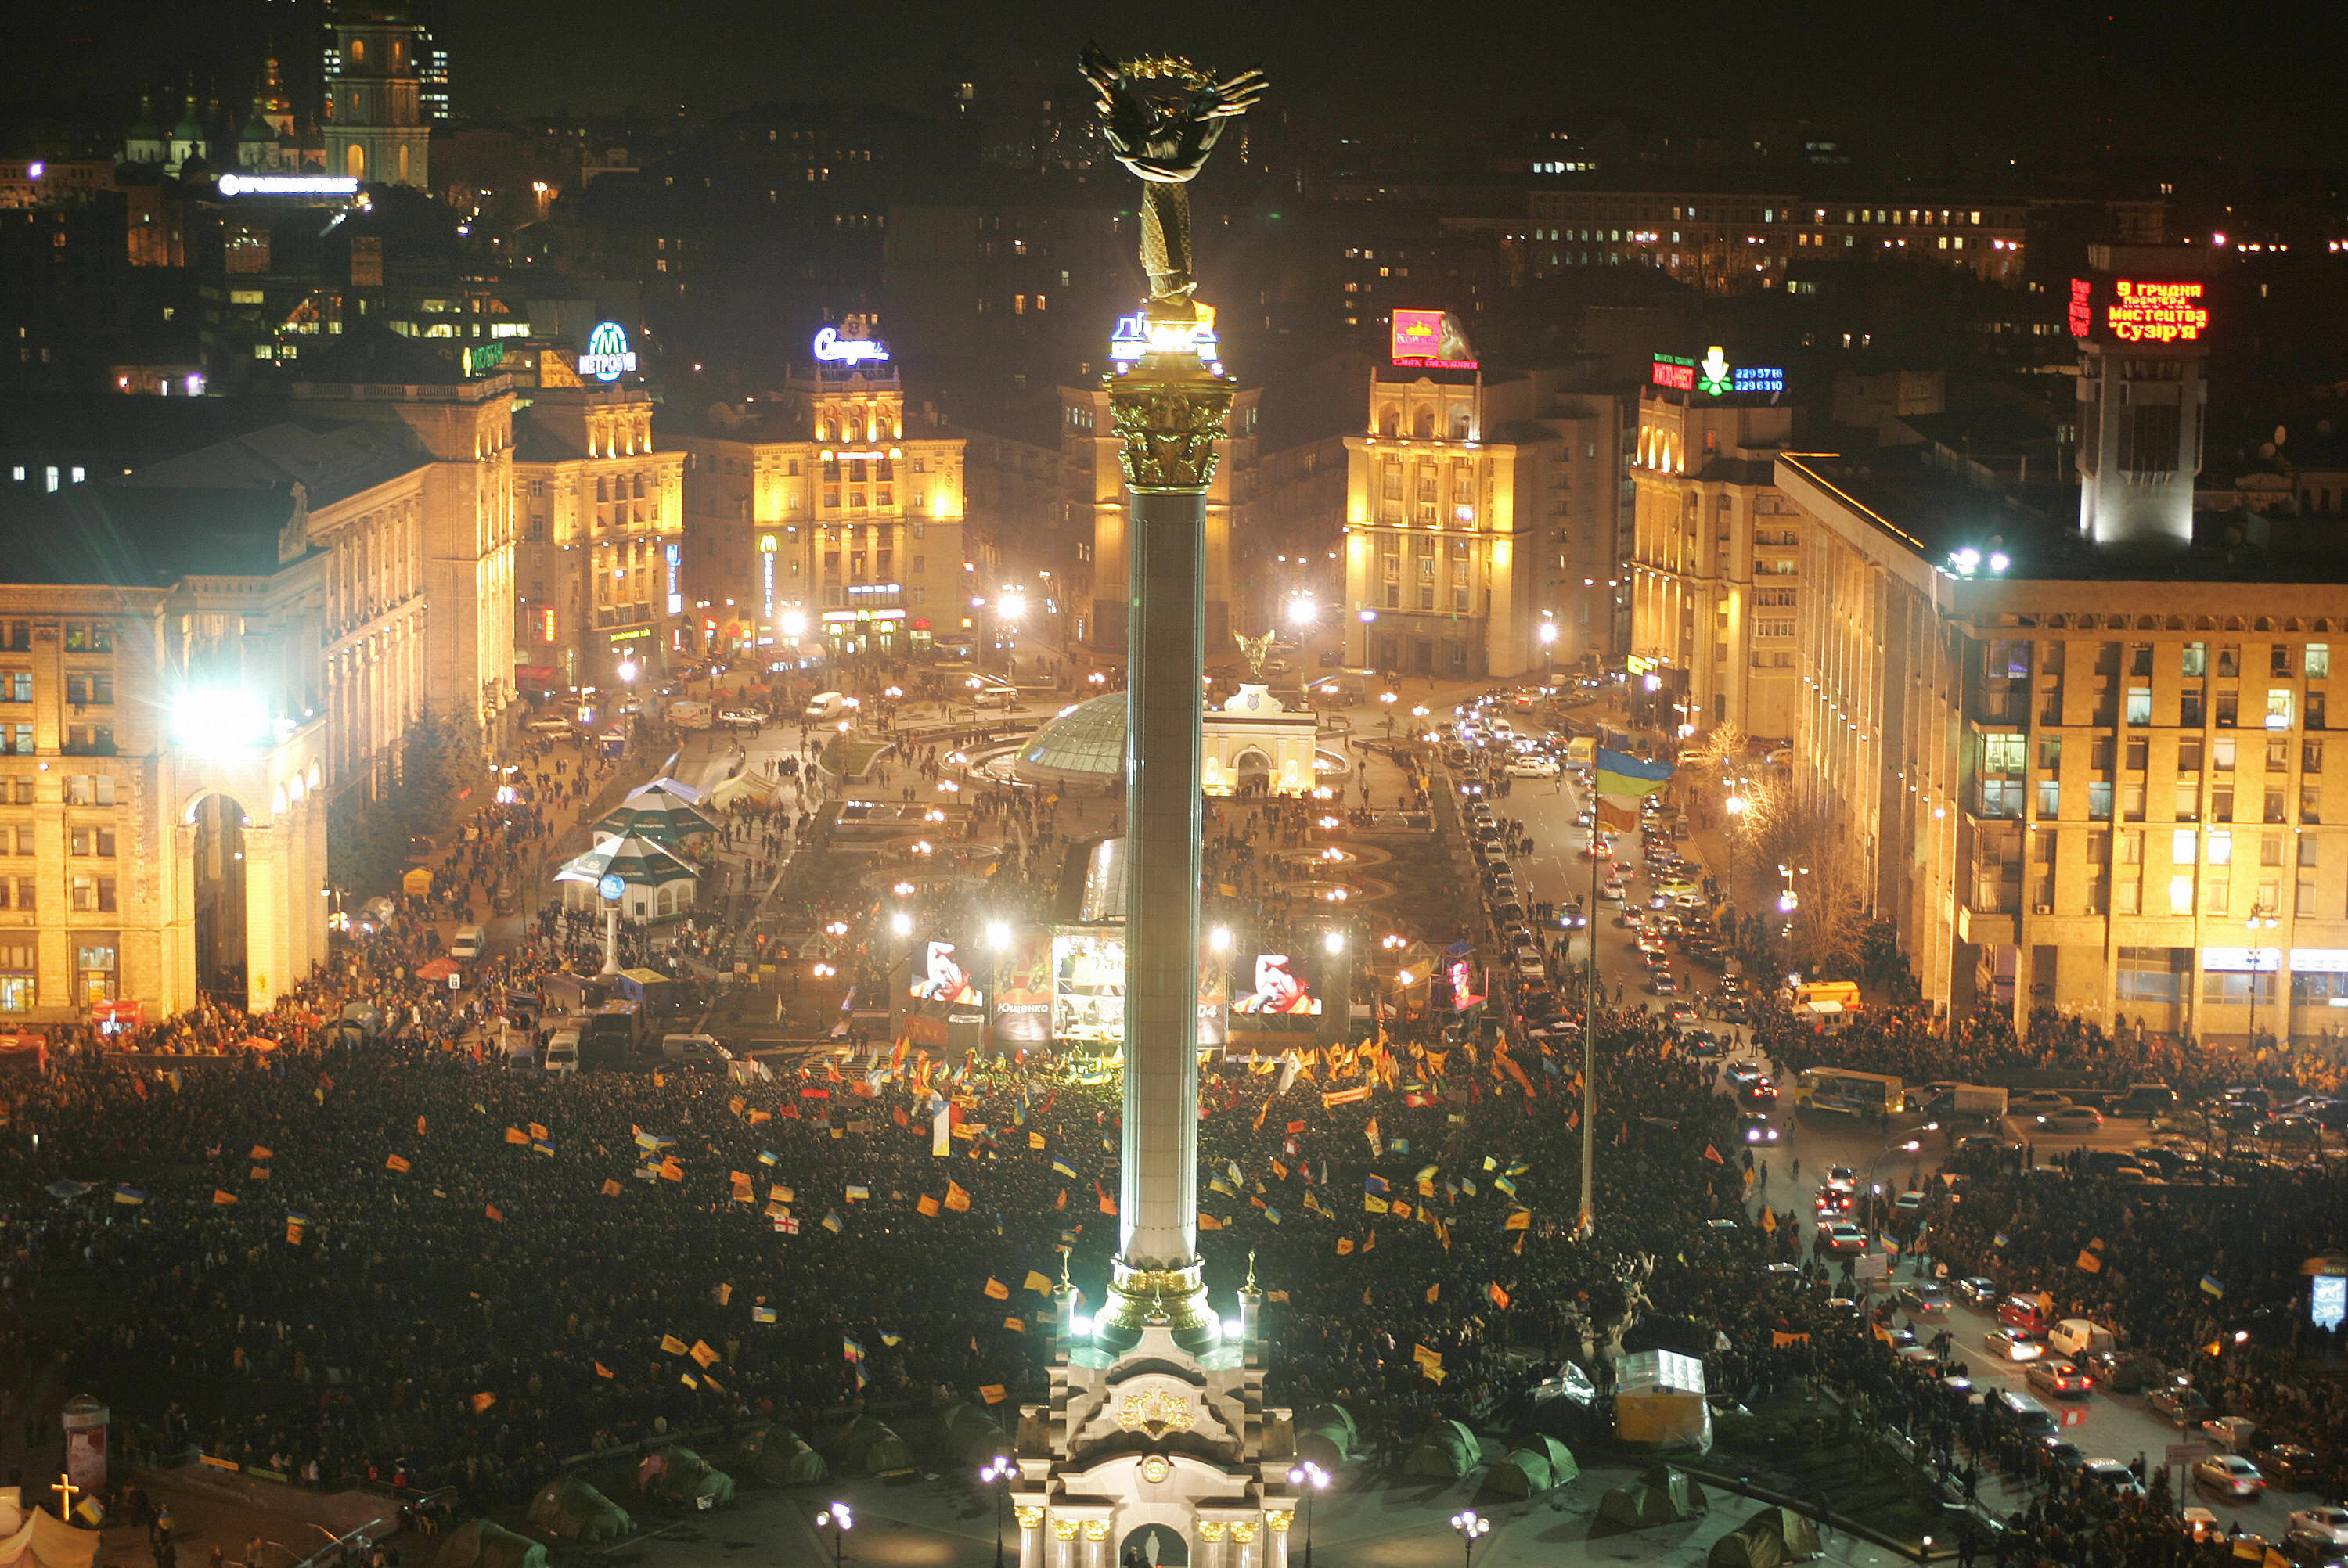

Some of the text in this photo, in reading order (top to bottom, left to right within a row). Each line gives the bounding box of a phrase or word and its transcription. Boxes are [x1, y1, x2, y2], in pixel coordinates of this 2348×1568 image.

[2116, 281, 2131, 296] 9
[578, 352, 636, 375] МЕТРОБУД
[997, 1002, 1049, 1014] Ющенко
[1197, 1004, 1218, 1018] 04
